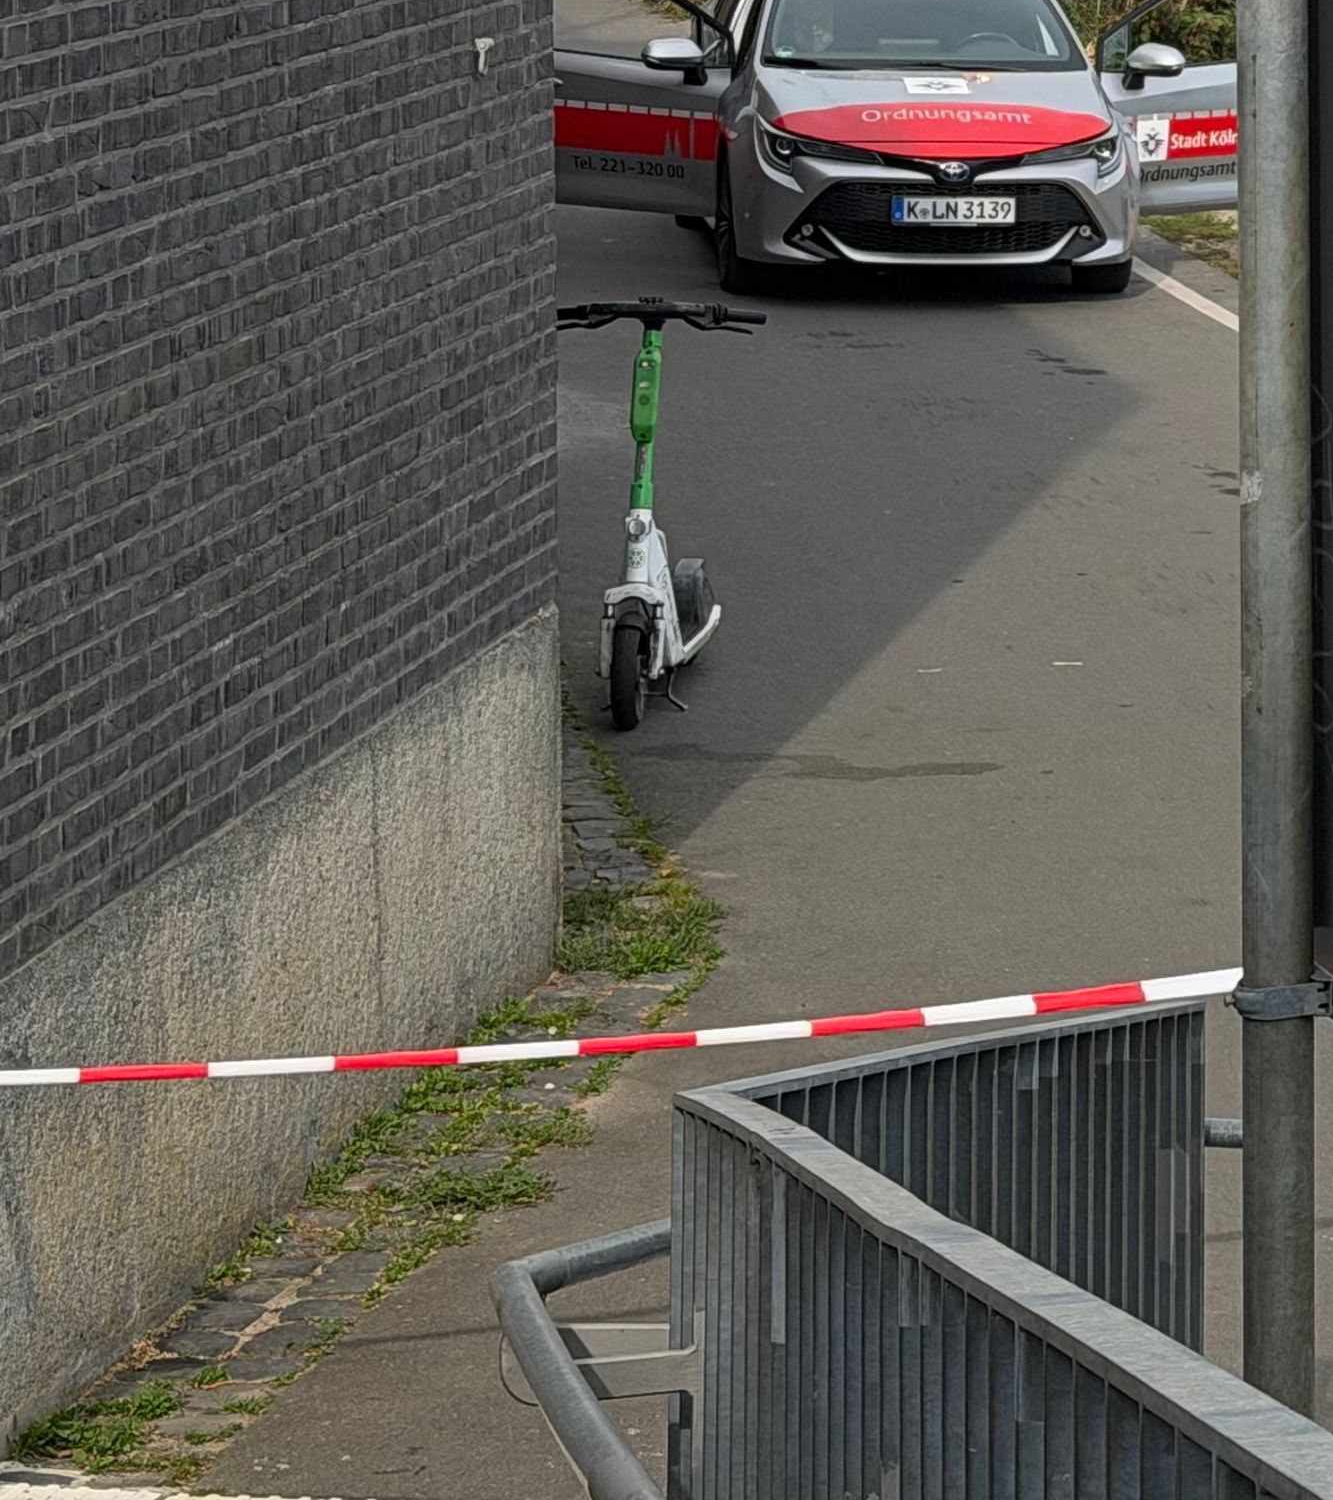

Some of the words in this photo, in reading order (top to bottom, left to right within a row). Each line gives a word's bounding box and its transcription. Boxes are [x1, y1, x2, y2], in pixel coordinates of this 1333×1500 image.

[861, 108, 1033, 125] Ordnungsamt
[1170, 131, 1208, 150] Stadt
[572, 155, 597, 171] Tel.
[601, 157, 664, 177] 221-320
[906, 201, 919, 219] K
[932, 201, 958, 219] LN
[963, 201, 1012, 219] 3139
